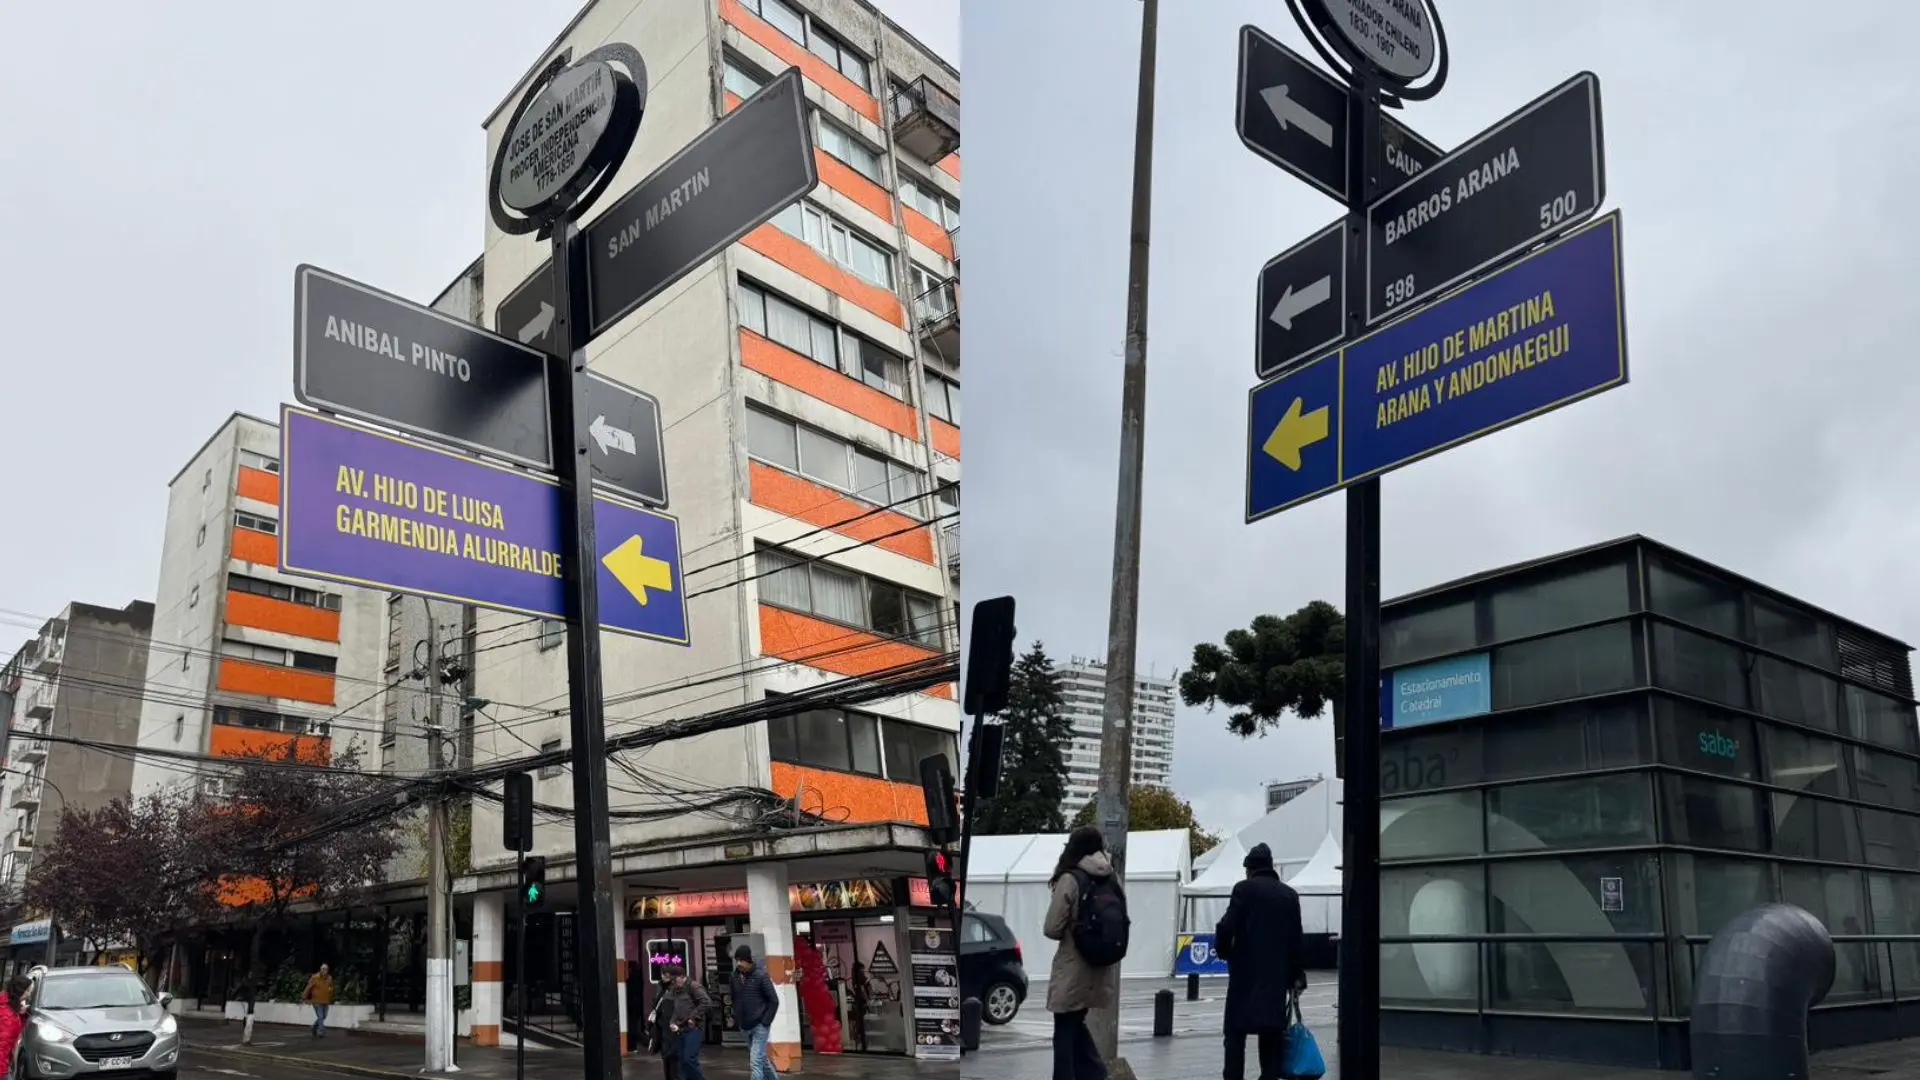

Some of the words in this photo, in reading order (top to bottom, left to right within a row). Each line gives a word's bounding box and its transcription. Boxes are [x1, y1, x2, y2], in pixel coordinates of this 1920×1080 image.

[1349, 9, 1369, 39] 1830
[1385, 20, 1421, 60] CHILENO
[510, 128, 531, 162] JOSE
[532, 118, 544, 142] DE
[545, 102, 563, 130] SAN
[565, 67, 602, 114] MARTIN
[510, 147, 539, 184] PROCER
[541, 92, 607, 155] INDEPENDENCIA
[533, 131, 579, 180] AMERICANA
[608, 218, 640, 259] SAN
[645, 166, 710, 231] MARTIN
[1385, 187, 1451, 246] BARROS
[1456, 146, 1521, 204] ARANA
[1540, 190, 1576, 230] 500
[1385, 274, 1415, 307] 598
[324, 314, 406, 362] ANIBAL
[411, 341, 471, 382] PINTO
[1376, 360, 1400, 394] AV.
[1403, 343, 1439, 381] HIJO
[1443, 330, 1465, 364] DE
[1469, 290, 1555, 353] MARTINA
[1376, 384, 1431, 430] ARANA
[1434, 376, 1446, 405] Y
[1448, 323, 1570, 400] ANDONAEGUI
[336, 465, 369, 499] AV.
[374, 473, 418, 510] HIJO
[423, 486, 448, 517] DE
[452, 494, 505, 531] LUISA
[336, 504, 458, 556] GARMENDIA
[463, 533, 563, 578] ALURRALDE
[1400, 671, 1480, 696] Estacionamiento
[1400, 695, 1442, 714] Catedral
[1381, 745, 1447, 791] aba
[1699, 728, 1735, 758] saba
